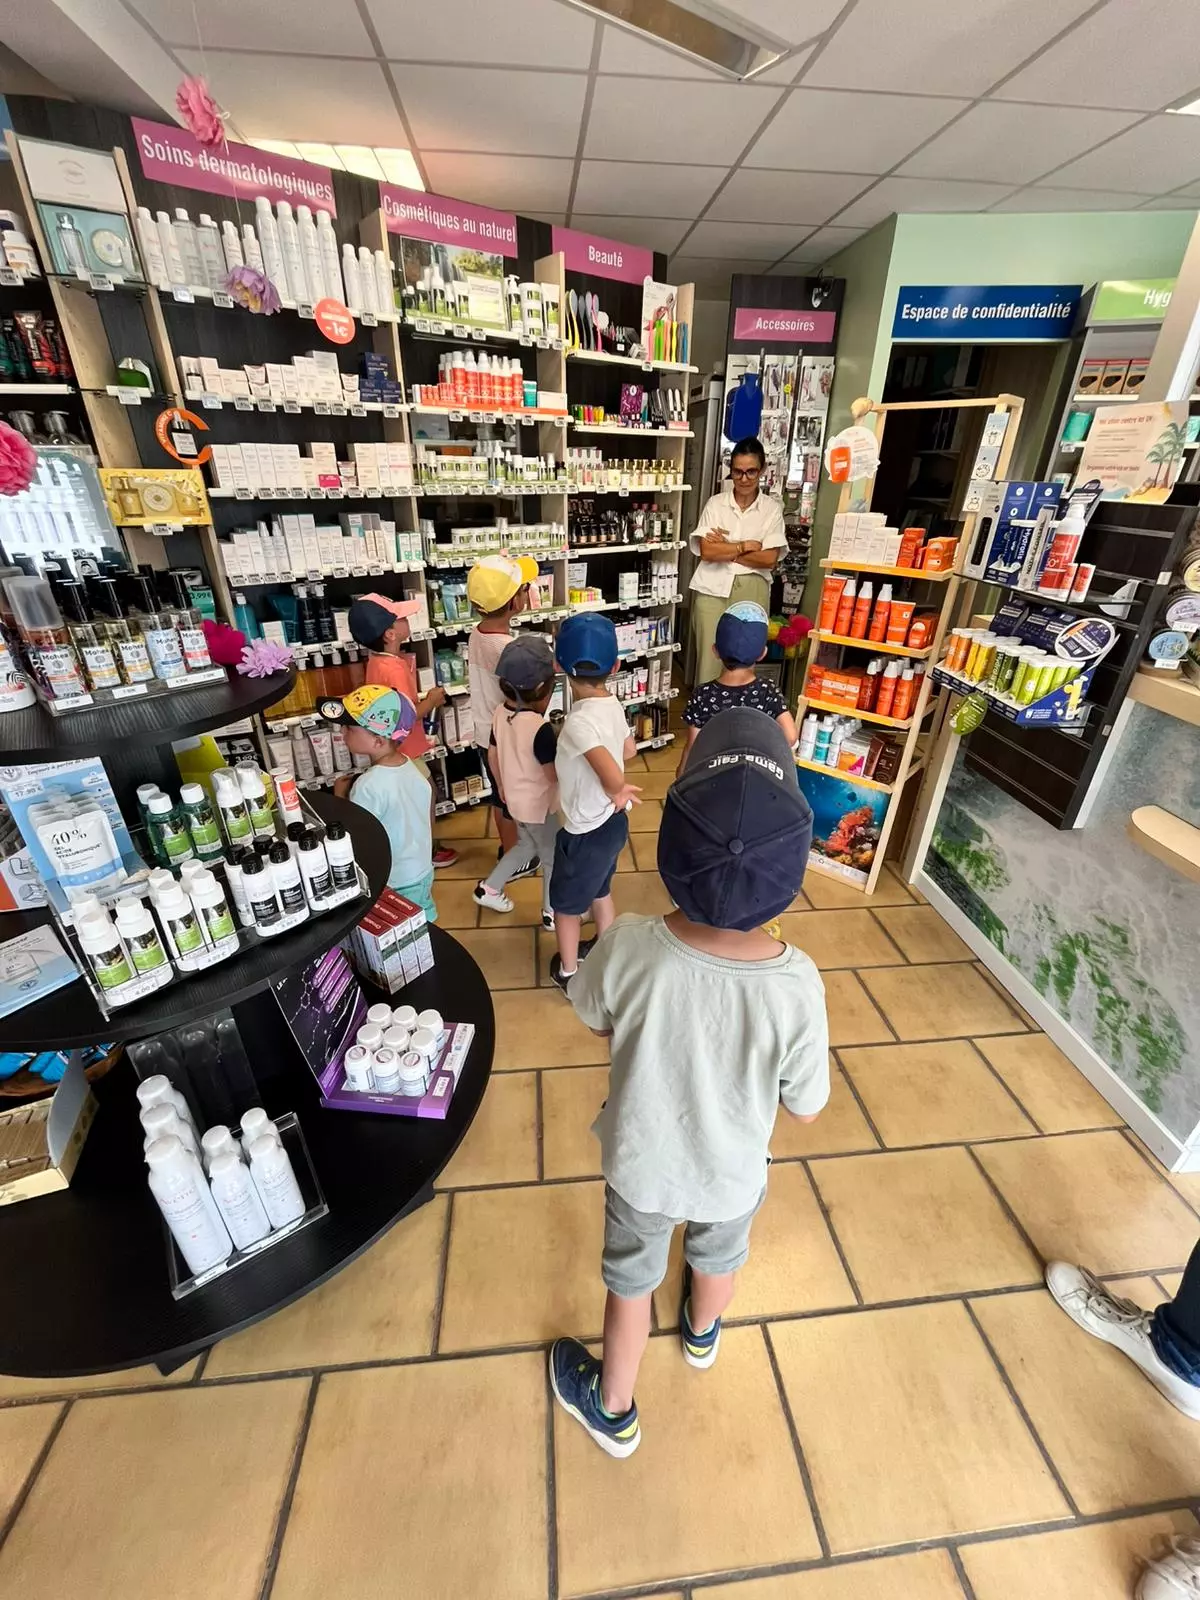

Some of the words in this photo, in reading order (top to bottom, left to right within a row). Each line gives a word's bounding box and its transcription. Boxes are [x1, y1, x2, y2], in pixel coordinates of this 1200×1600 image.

[140, 133, 194, 168] Soins
[198, 148, 332, 202] dermatologiques
[383, 194, 460, 231] Cosmétiques
[462, 217, 477, 234] au
[479, 216, 516, 244] naturel
[588, 244, 624, 268] Beauté
[1143, 288, 1172, 310] Hyg
[755, 316, 816, 332] Accessoires
[901, 303, 949, 324] Espace
[952, 303, 968, 319] de
[971, 301, 1071, 319] confidentialité
